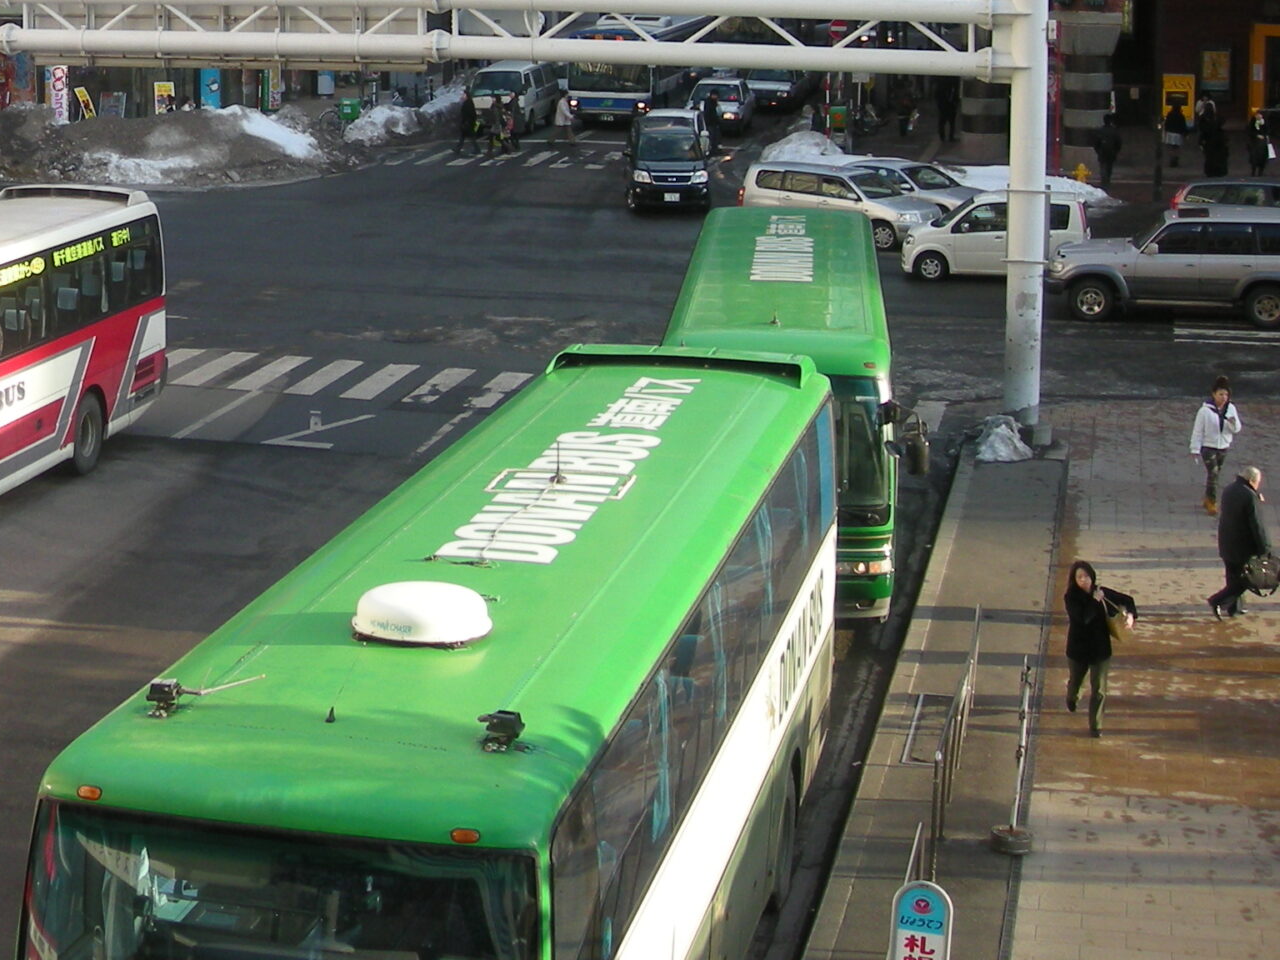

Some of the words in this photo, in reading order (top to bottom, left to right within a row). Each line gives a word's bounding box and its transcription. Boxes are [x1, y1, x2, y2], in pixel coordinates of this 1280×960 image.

[587, 376, 701, 430] 道南バス
[528, 432, 661, 474] BUS
[434, 472, 618, 564] DONAN
[779, 602, 808, 724] DONAN
[808, 569, 824, 657] BUS
[900, 915, 943, 930] じょうてつ
[903, 934, 936, 960] 札
